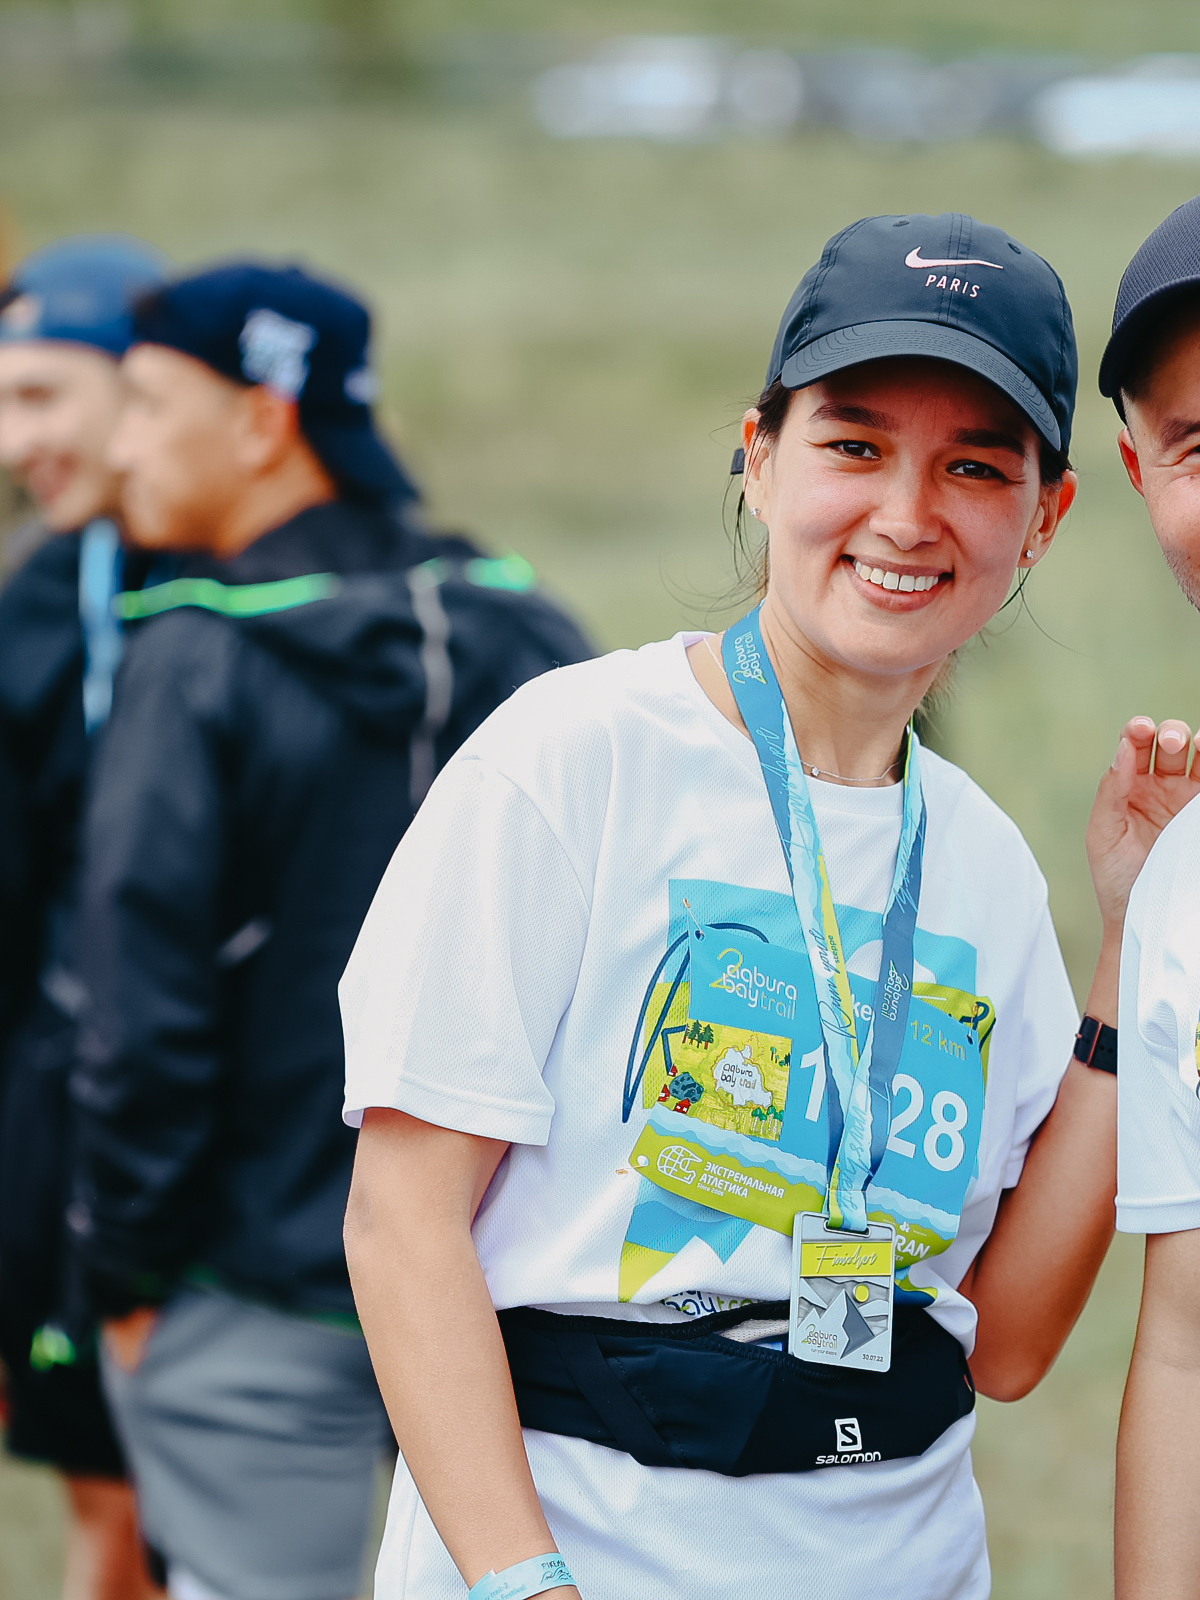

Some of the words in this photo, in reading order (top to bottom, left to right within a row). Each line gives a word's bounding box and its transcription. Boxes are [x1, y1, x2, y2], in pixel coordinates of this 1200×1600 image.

[925, 274, 981, 298] PARIS
[828, 935, 840, 964] steppe
[726, 964, 798, 1001] aqbura
[910, 1019, 934, 1045] 12
[938, 1030, 966, 1061] km
[720, 1071, 737, 1088] bay
[739, 1078, 757, 1090] trail
[800, 1041, 969, 1172] 128
[699, 1173, 749, 1199] АТЛЕТИКА
[703, 1161, 786, 1199] ЭКСТРЕМАЛЬНАЯ
[710, 1187, 725, 1197] 2006
[815, 1244, 877, 1274] Finisher
[895, 1234, 931, 1258] RAN
[815, 1451, 881, 1464] salomon
